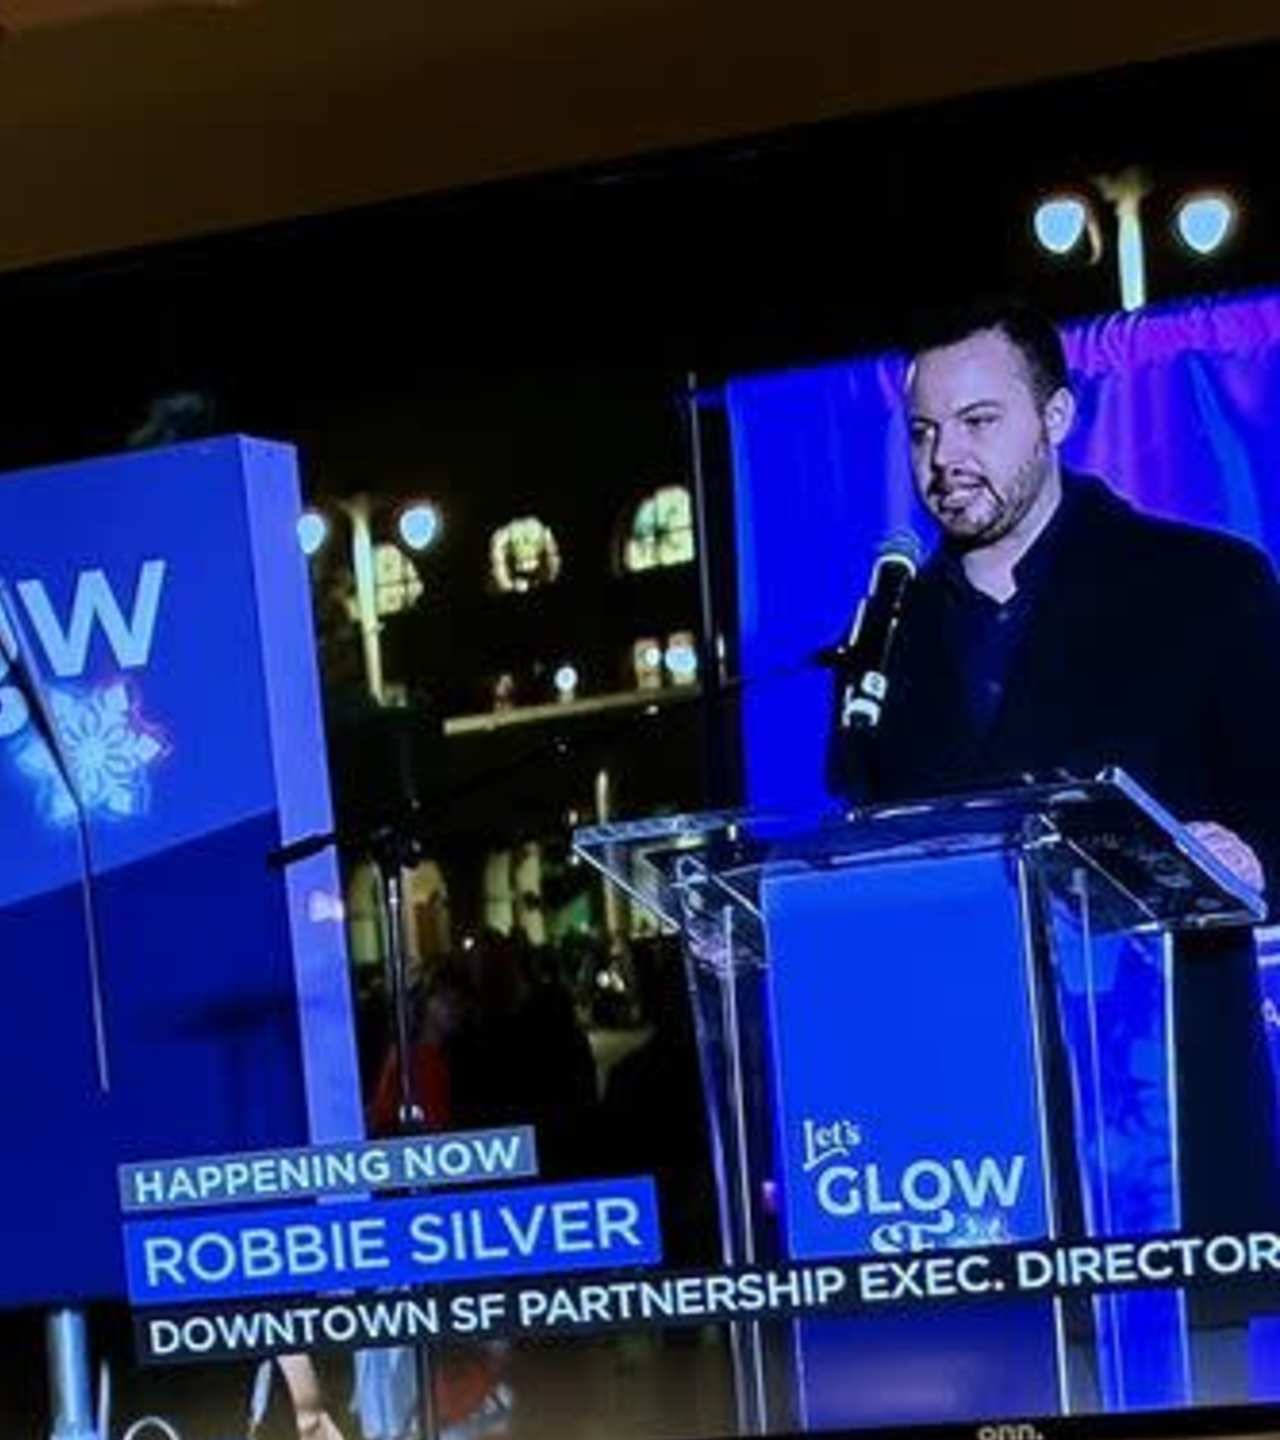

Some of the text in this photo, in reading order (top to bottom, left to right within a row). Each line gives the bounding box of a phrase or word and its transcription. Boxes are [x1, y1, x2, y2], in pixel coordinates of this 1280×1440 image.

[134, 1135, 522, 1204] HAPPENING NOW
[816, 1155, 1027, 1217] GLOW
[144, 1198, 642, 1288] ROBBIE SILVER
[149, 1231, 1280, 1355] DOWNTOWN SF PARTNERSHIP EXEC. DIRECTOR
